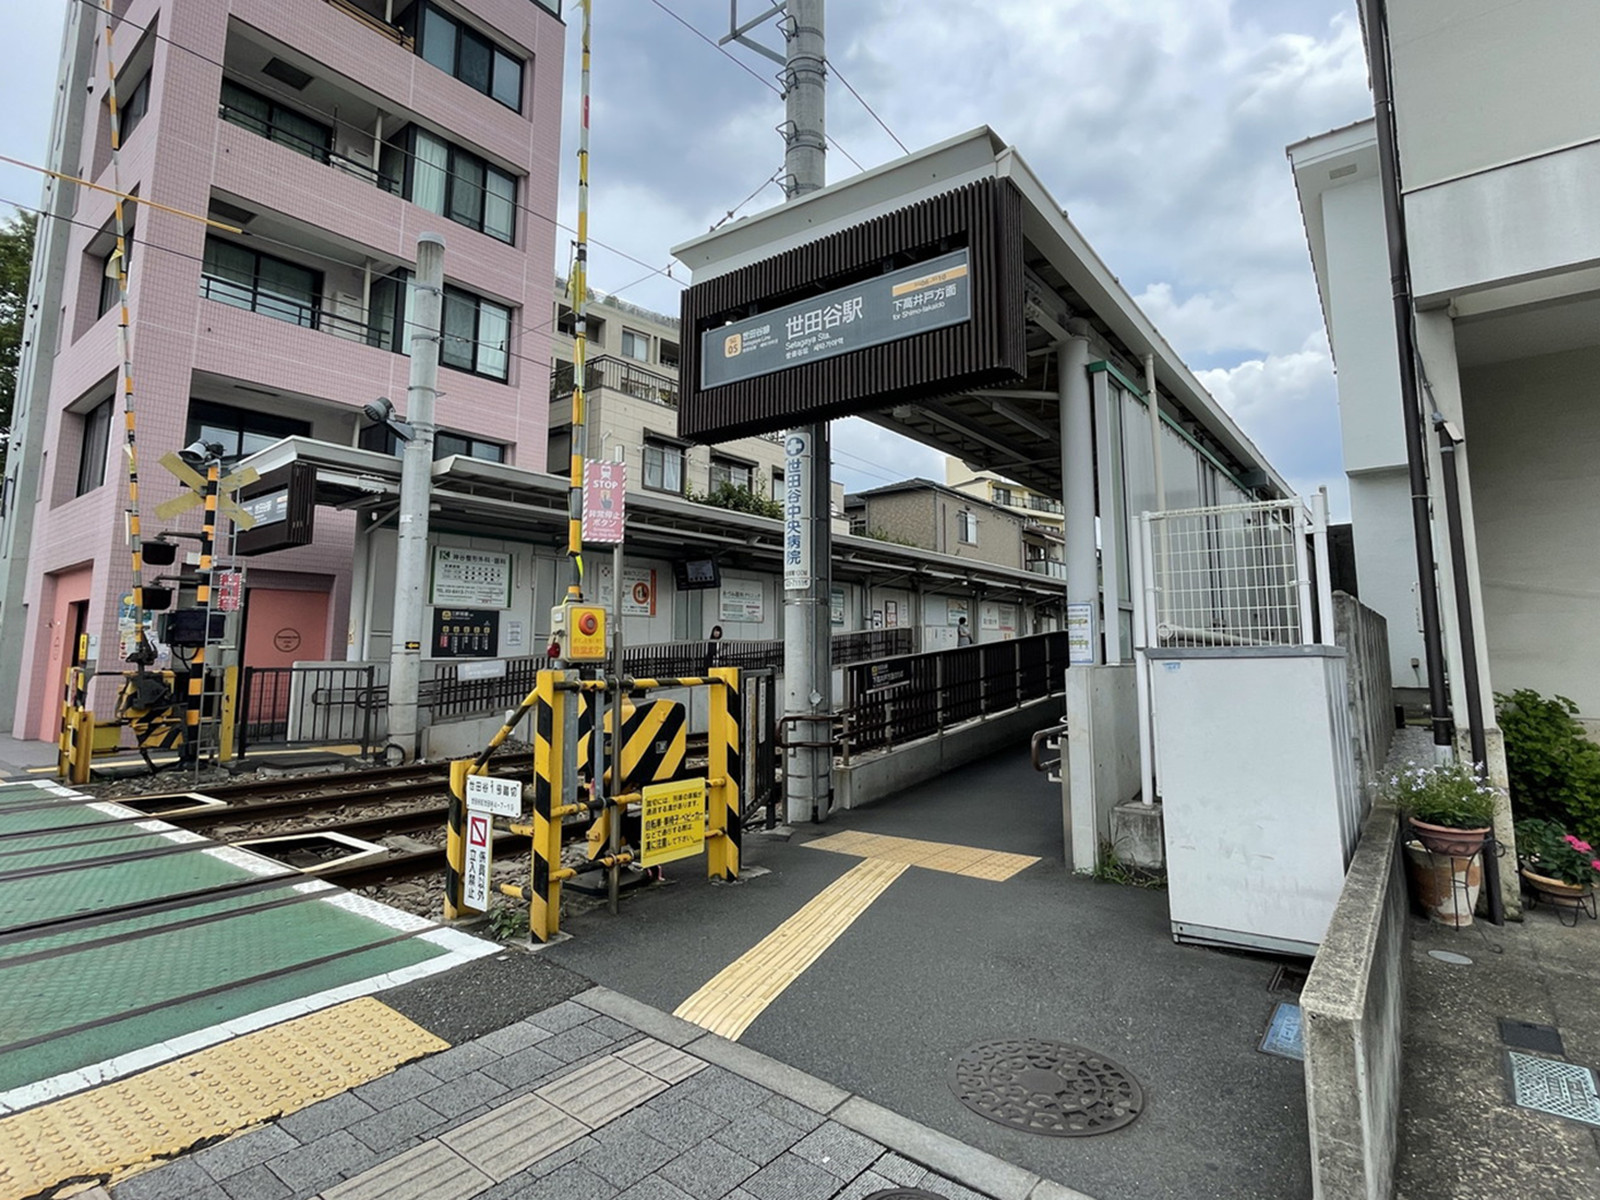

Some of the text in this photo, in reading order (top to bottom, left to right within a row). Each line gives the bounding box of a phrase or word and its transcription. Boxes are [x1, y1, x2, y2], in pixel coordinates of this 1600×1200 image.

[893, 283, 957, 311] 下高井戸方面
[785, 296, 863, 340] 世田谷駅
[728, 344, 738, 354] 05
[785, 336, 817, 351] Setagaya
[592, 480, 619, 490] STOP
[588, 509, 621, 520] 非常停止
[787, 459, 801, 565] 世田谷中央病院
[592, 519, 617, 528] ボタン
[468, 849, 477, 899] 立入禁止
